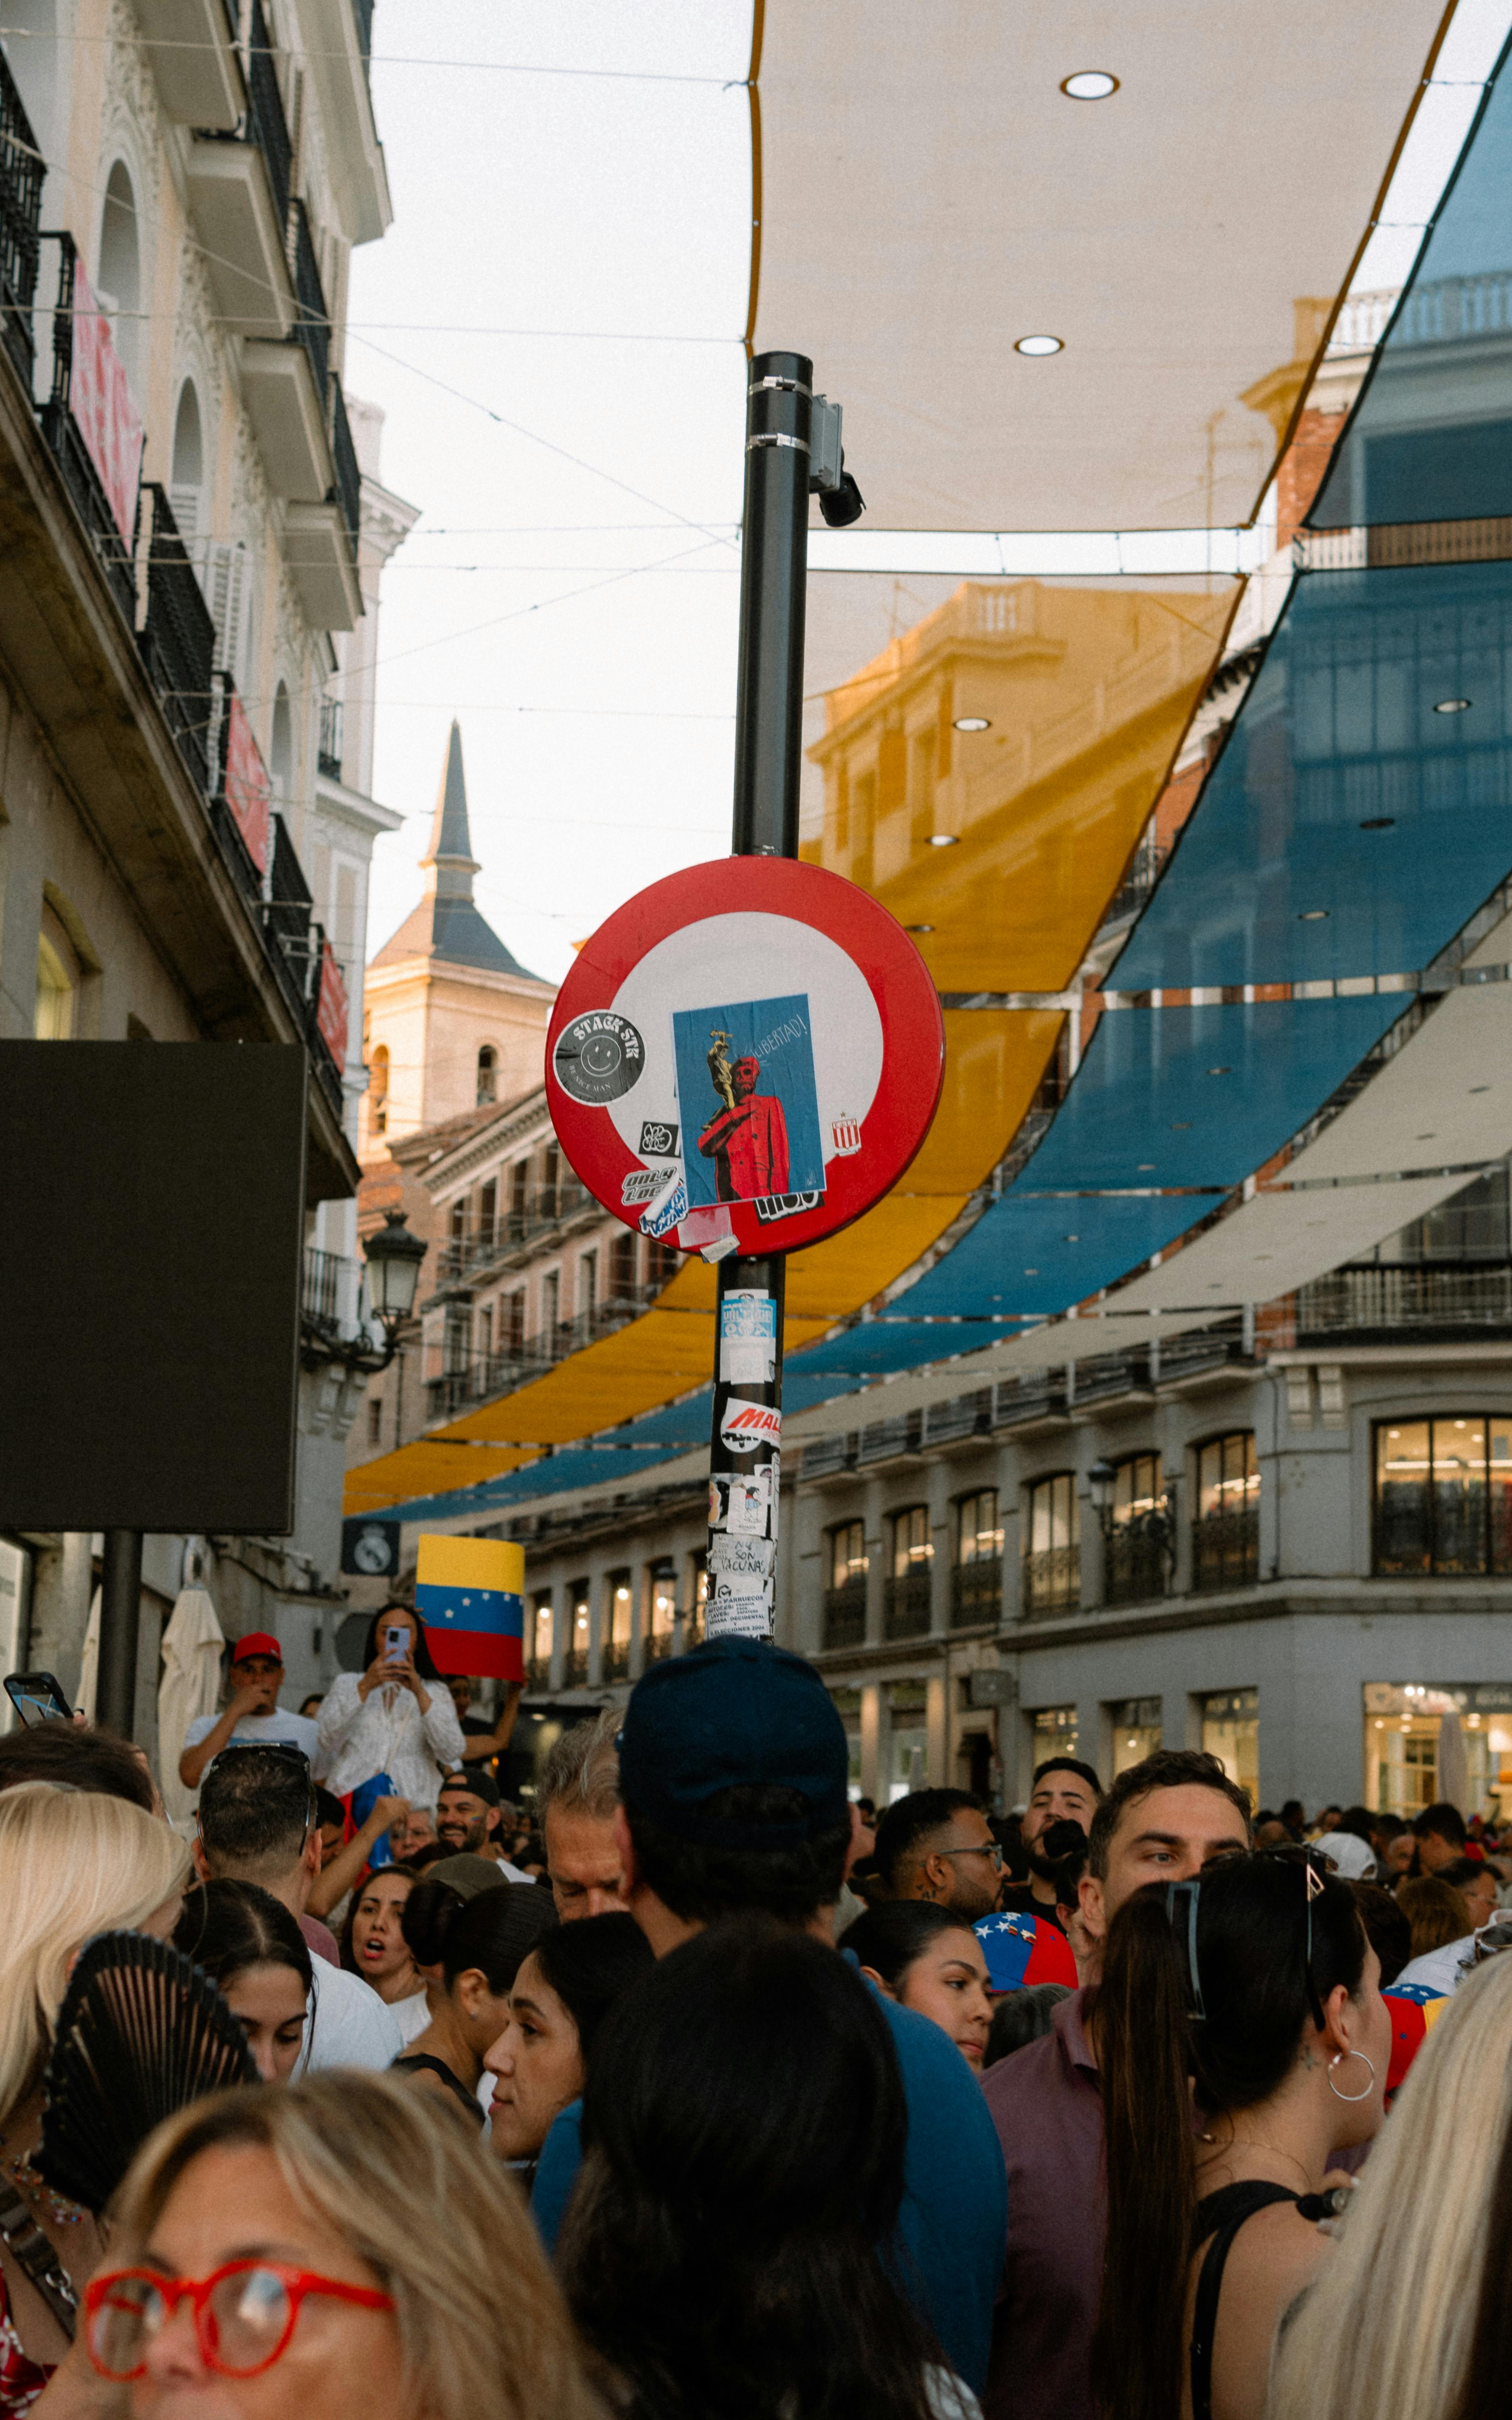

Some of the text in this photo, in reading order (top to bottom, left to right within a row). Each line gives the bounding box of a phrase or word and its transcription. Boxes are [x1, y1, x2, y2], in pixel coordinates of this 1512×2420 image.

[573, 1016, 639, 1059] STACK STK
[569, 1065, 576, 1075] BE
[735, 1550, 755, 1560] SON
[723, 1595, 764, 1603] MARRUECOS
